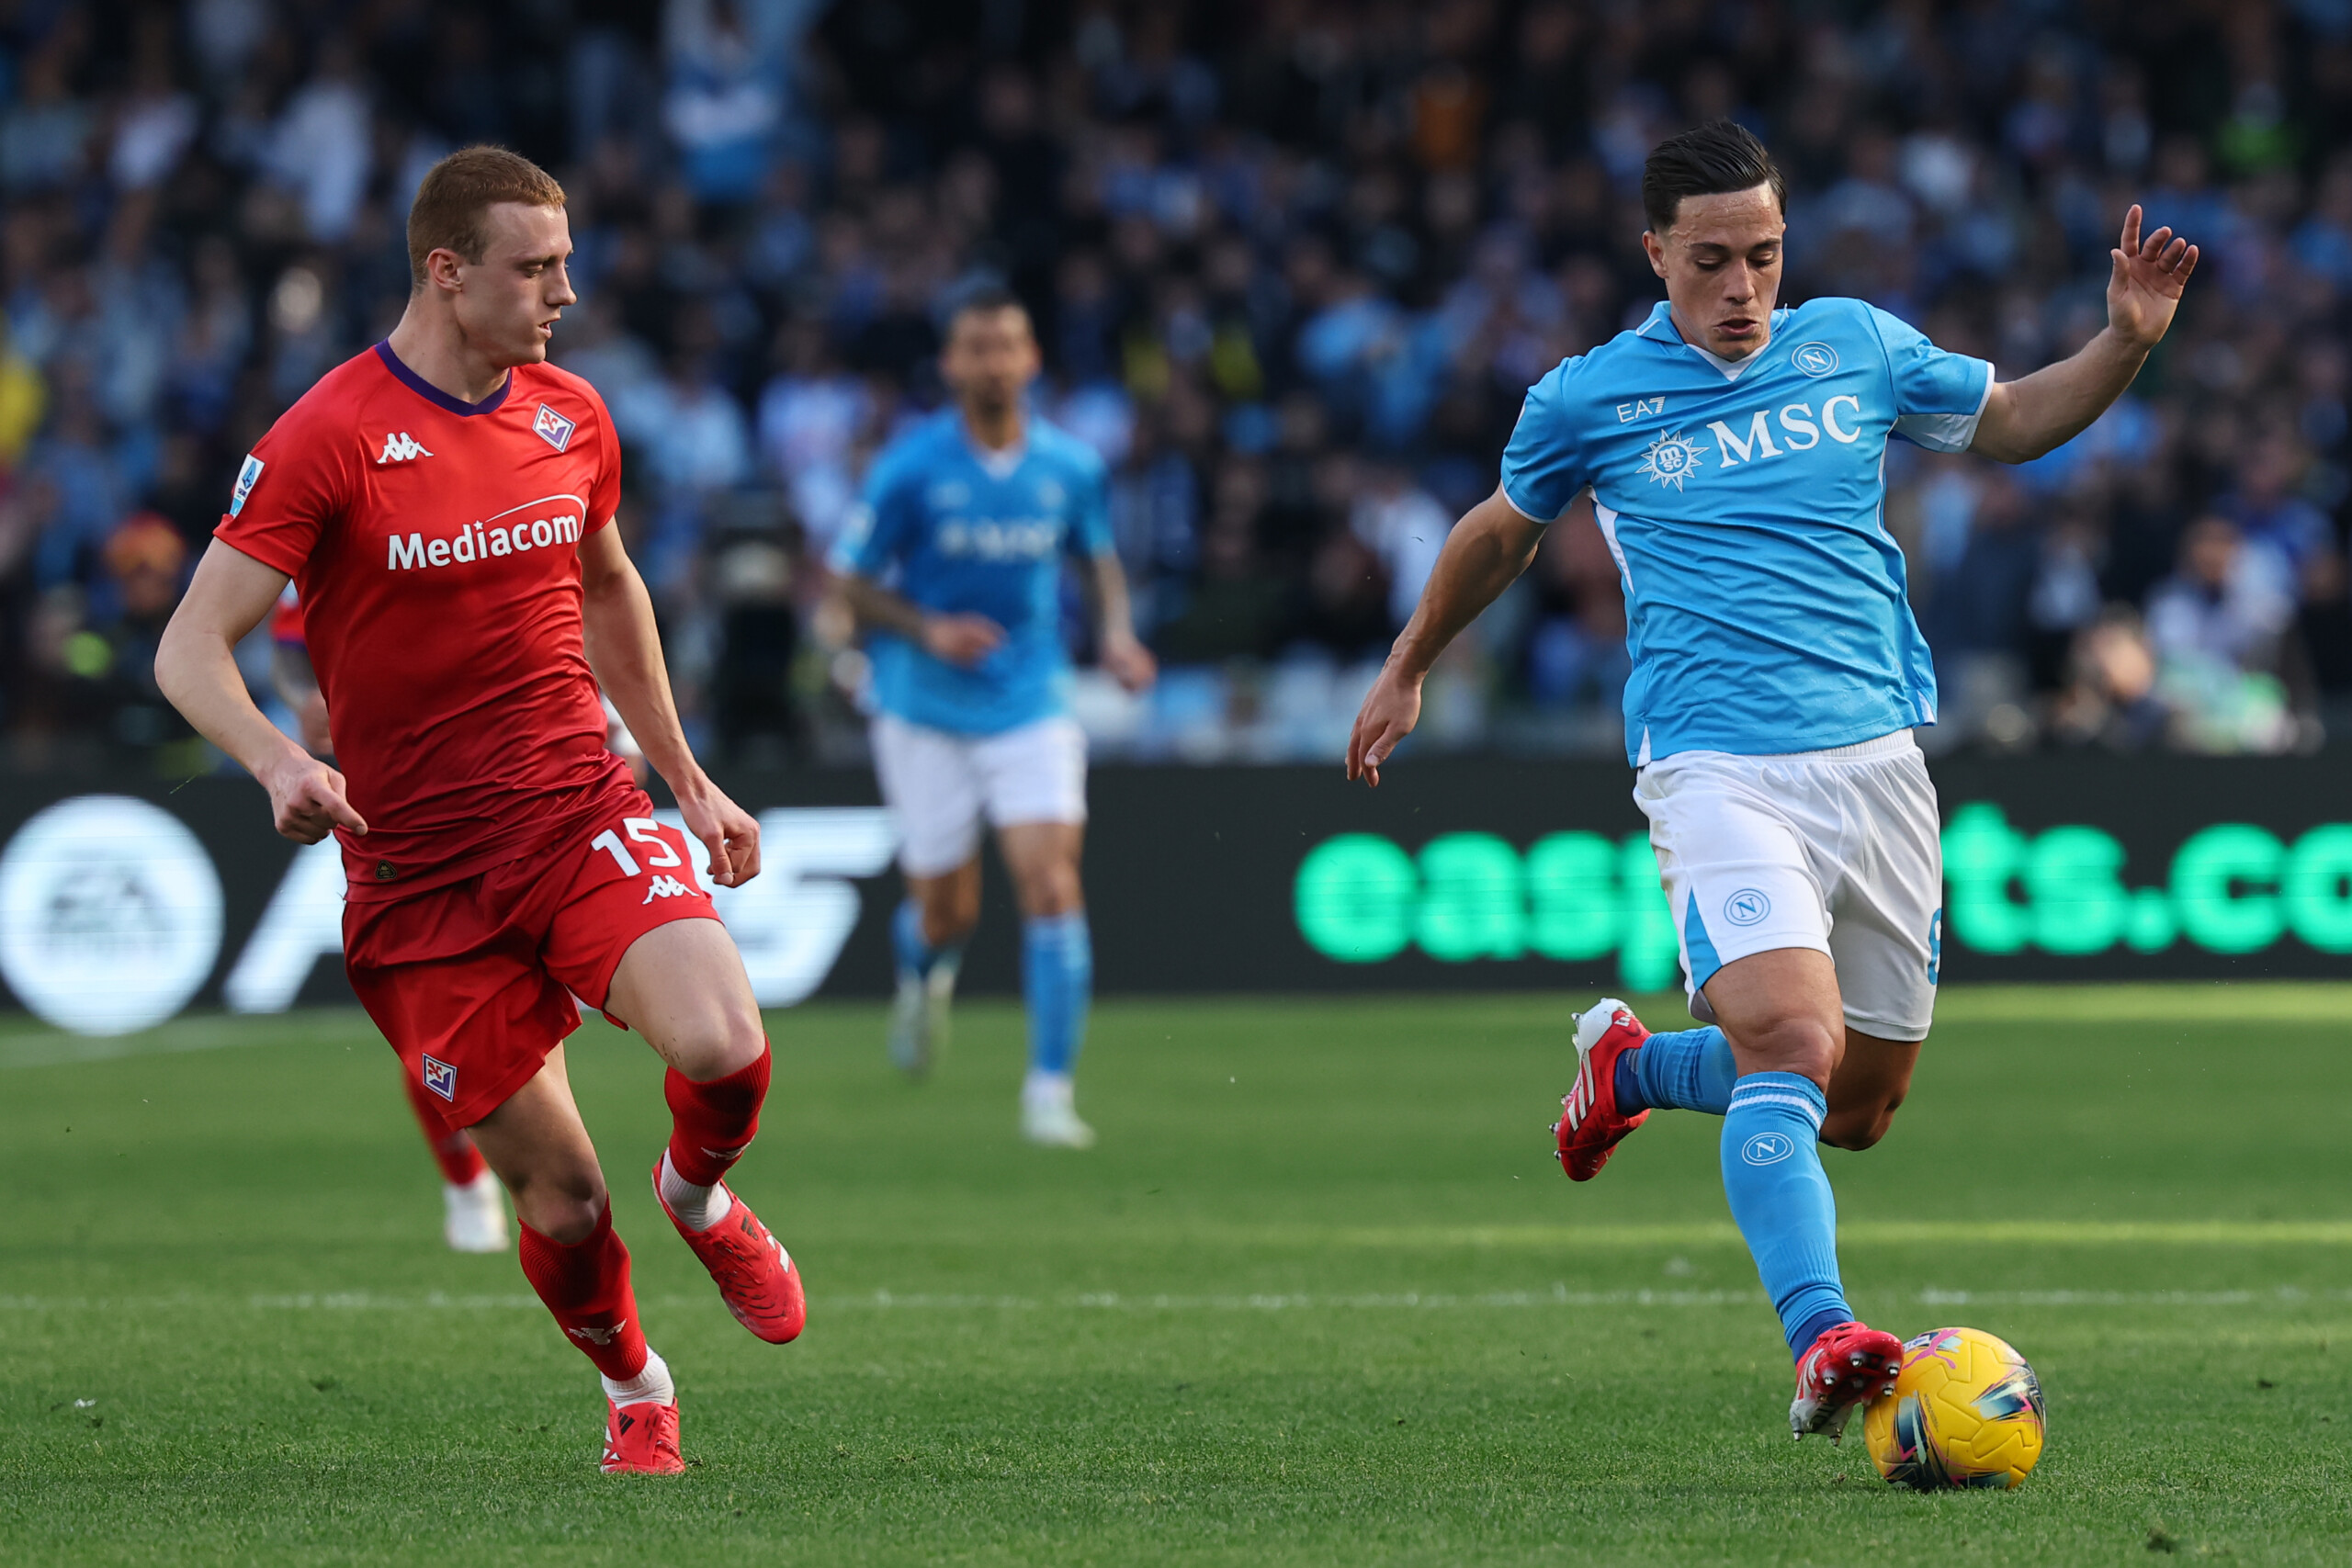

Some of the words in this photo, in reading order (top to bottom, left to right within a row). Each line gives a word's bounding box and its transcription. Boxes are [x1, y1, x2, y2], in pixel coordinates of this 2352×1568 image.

[1802, 351, 1827, 369] N
[1616, 396, 1666, 423] EA7
[1706, 395, 1861, 468] MSC
[388, 513, 579, 570] Mediacom
[591, 818, 682, 876] 15
[1735, 897, 1758, 918] N
